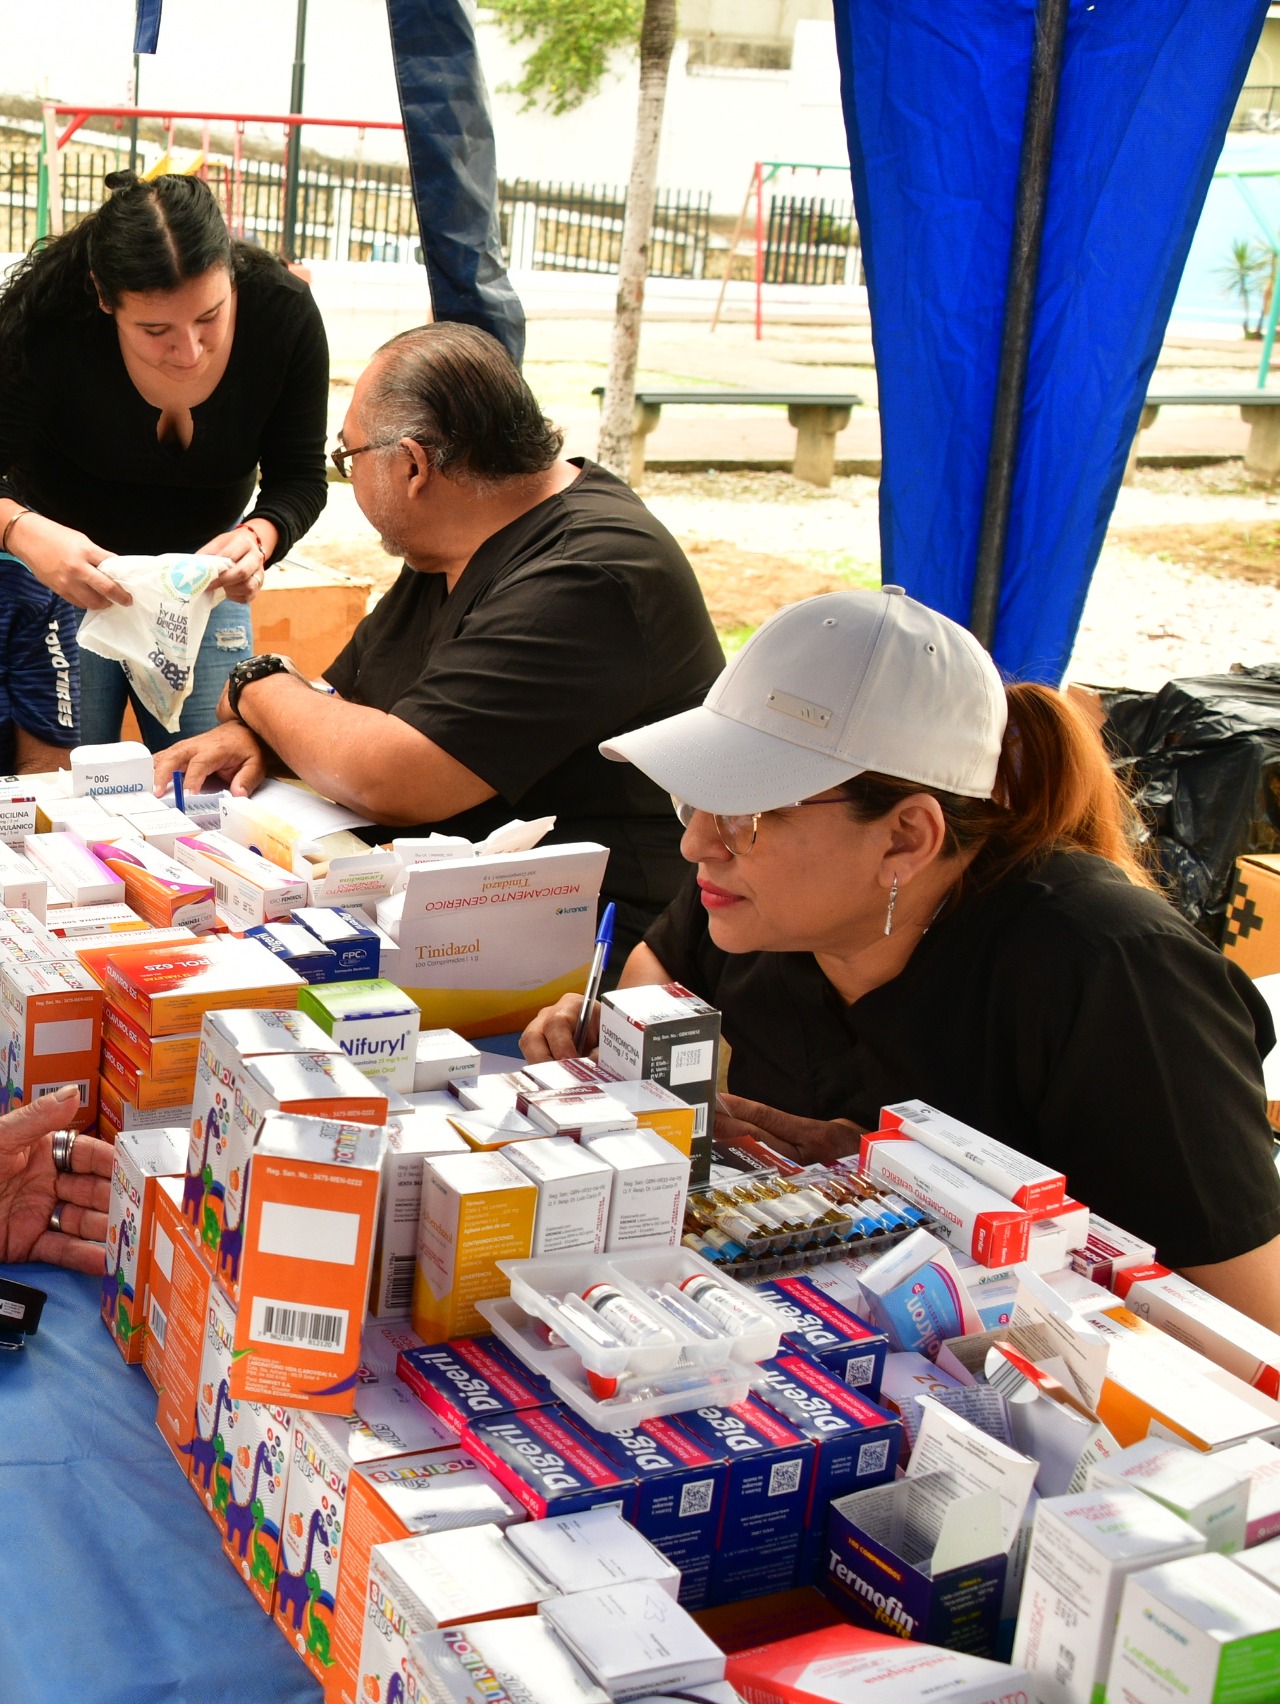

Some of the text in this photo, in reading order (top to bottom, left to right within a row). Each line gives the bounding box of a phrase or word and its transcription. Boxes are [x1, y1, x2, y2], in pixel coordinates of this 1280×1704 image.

[48, 619, 75, 729] TOYO TIRES
[94, 775, 109, 783] 500
[482, 878, 531, 893] Tinidazol
[491, 884, 580, 903] MEDICAMENTO
[563, 905, 588, 914] kronos
[342, 951, 361, 960] FPC
[415, 939, 481, 960] Tinidazol
[144, 963, 172, 972] 625
[415, 961, 426, 969] 100
[426, 957, 466, 967] Comprimidos
[340, 1033, 406, 1057] Nifuryl
[601, 1024, 640, 1060] CLARITROMICINA
[603, 1035, 613, 1048] 250
[612, 1044, 621, 1057] mg
[914, 1188, 964, 1228] MEDICAMENTO
[419, 1352, 503, 1411] Digeril
[764, 1370, 851, 1432] Digeril
[372, 1423, 407, 1448] PLUS
[293, 1452, 316, 1483] PLUS
[294, 1429, 347, 1501] SUTRIBOL
[486, 1424, 581, 1490] Digeril
[368, 1459, 477, 1484] SUTRIBOL
[828, 1549, 915, 1632] Termofin
[368, 1602, 393, 1641] PLUS
[874, 1606, 911, 1640] forte
